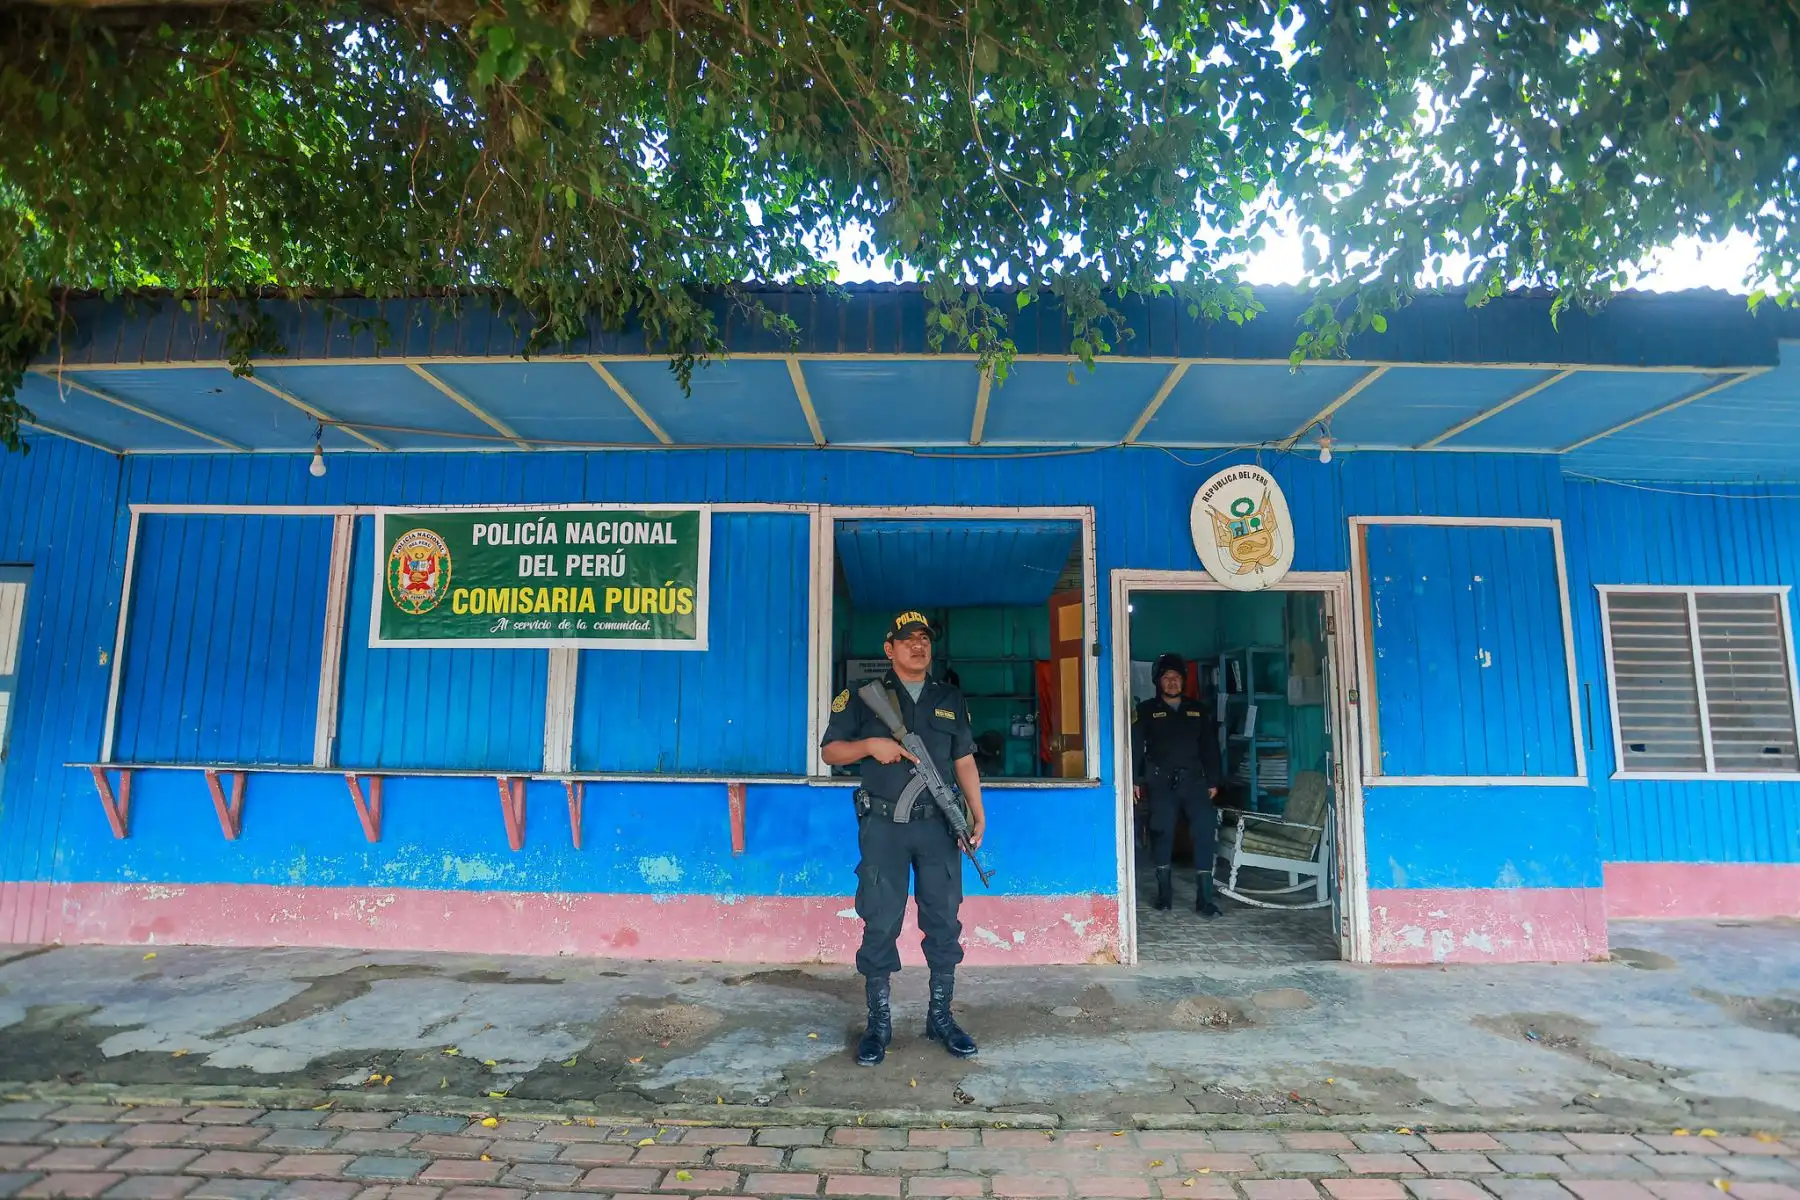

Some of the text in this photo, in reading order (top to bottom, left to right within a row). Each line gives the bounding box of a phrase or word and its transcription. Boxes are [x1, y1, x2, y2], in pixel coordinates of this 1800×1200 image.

[1202, 473, 1238, 503] REPUBLICA
[1238, 471, 1251, 479] DEL
[417, 532, 445, 553] NACIONAL
[472, 516, 678, 546] POLICÍA NACIONAL
[518, 548, 626, 577] DEL PERÚ
[452, 580, 694, 615] COMISARIA PURÚS
[489, 617, 651, 633] Al servicio de la comunidad.
